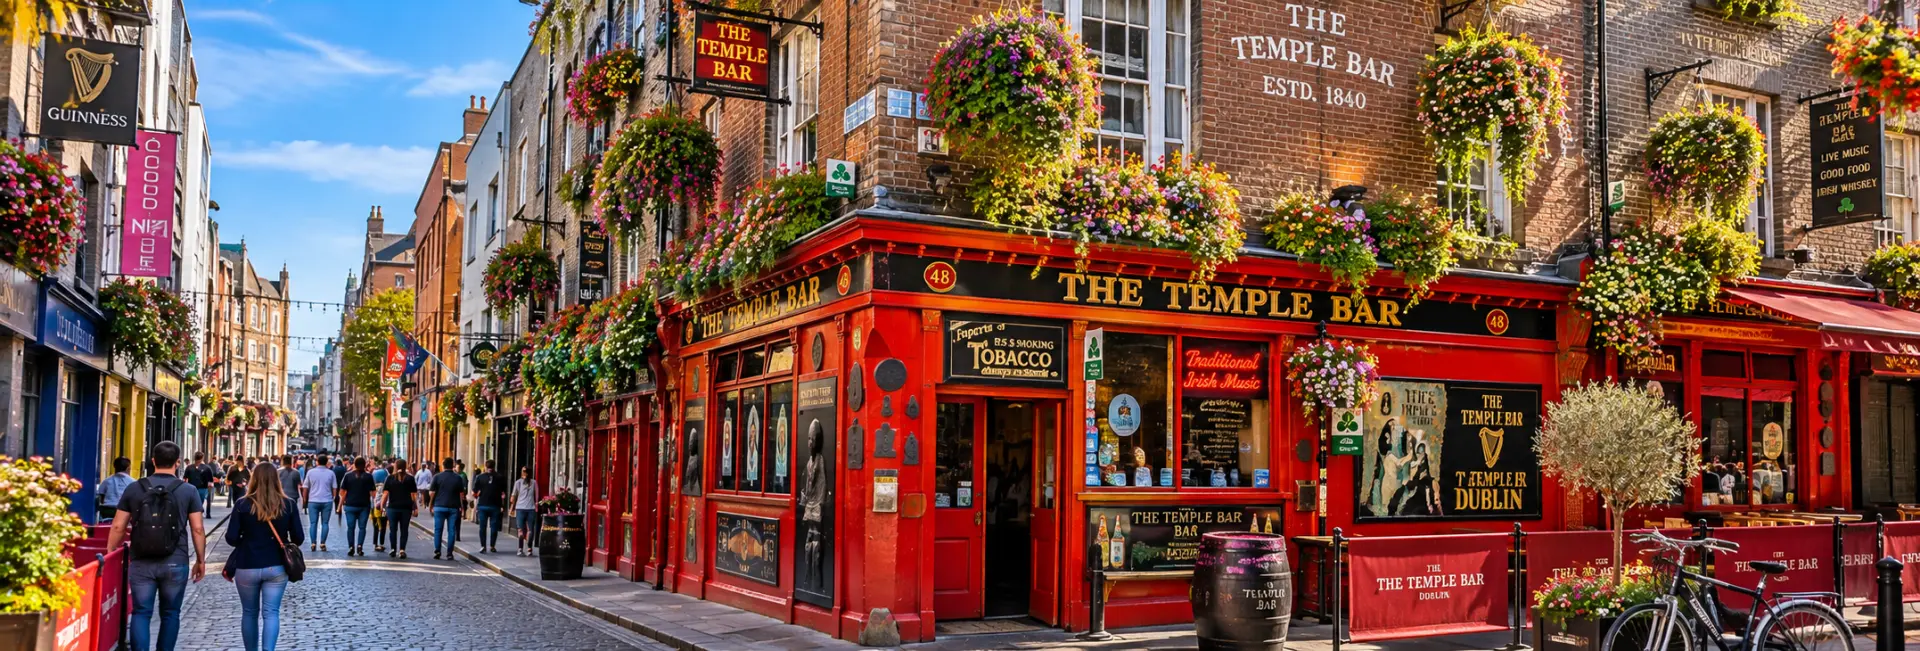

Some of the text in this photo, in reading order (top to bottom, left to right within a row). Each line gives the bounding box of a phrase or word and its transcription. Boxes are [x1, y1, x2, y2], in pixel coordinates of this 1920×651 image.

[1285, 3, 1346, 36] THE
[717, 23, 751, 42] THE
[696, 37, 768, 64] TEMPLE
[713, 60, 753, 81] BAR
[1231, 35, 1394, 87] TEMPLE BAR
[1262, 75, 1367, 109] ESTD. 1840
[47, 106, 128, 129] GUINNESS
[1821, 145, 1870, 163] LIVE MUSIC
[1820, 162, 1871, 181] GOOD FOOD
[1840, 178, 1878, 193] WHISKEY
[929, 268, 950, 284] 48
[701, 275, 821, 339] THE TEMPLE BAR
[1058, 271, 1402, 327] THE TEMPLE BAR
[1490, 315, 1504, 328] 48
[1016, 339, 1054, 350] SMOKING
[967, 339, 1052, 370] TOBACCO
[1185, 349, 1261, 370] Traditional
[1183, 370, 1261, 390] Irish Music
[1482, 394, 1503, 409] THE
[1454, 487, 1523, 510] DUBLIN
[1131, 511, 1242, 524] THE TEMPLE BAR
[1174, 525, 1198, 537] BAR
[1798, 558, 1818, 570] BAR
[1376, 572, 1484, 591] THE TEMPLE BAR
[1256, 599, 1277, 610] BAR
